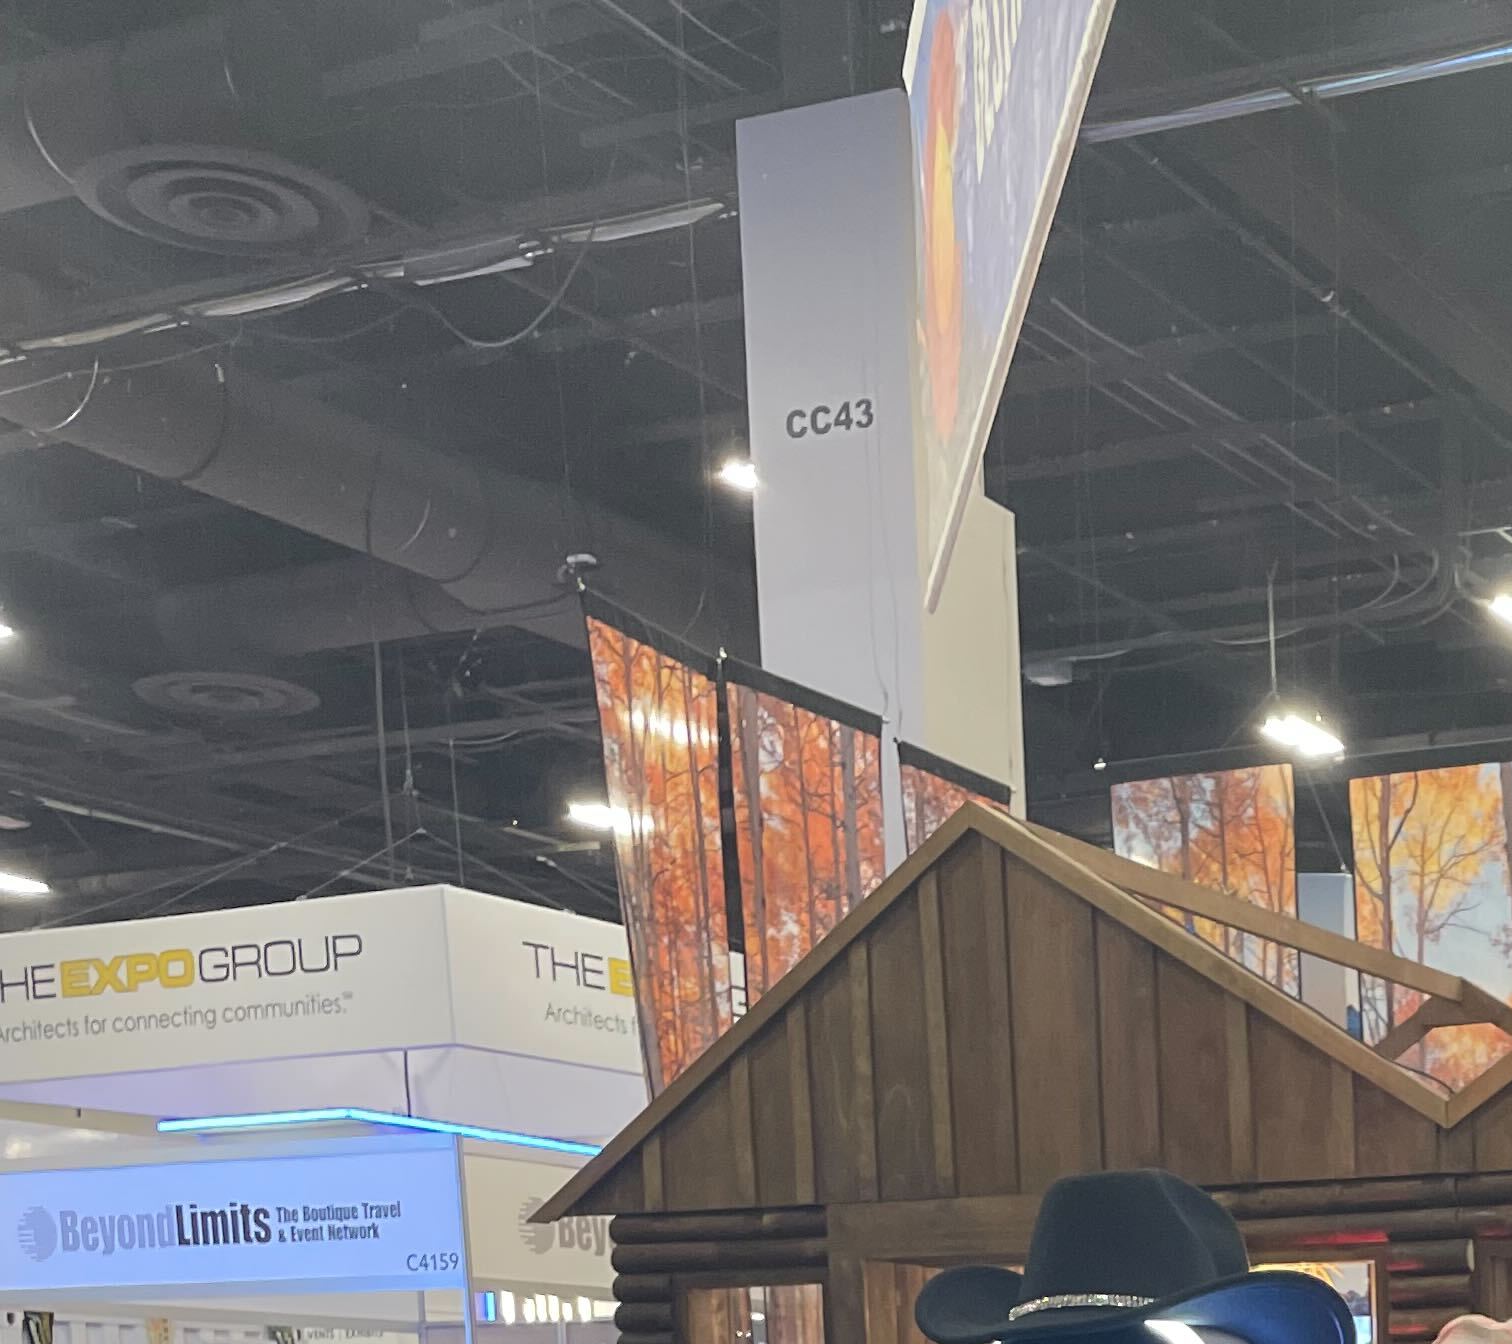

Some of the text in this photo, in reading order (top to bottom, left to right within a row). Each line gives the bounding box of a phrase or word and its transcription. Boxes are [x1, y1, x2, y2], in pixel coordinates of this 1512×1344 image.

[786, 398, 874, 438] CC43
[0, 934, 363, 1001] HE EXPO GROUP
[84, 1015, 107, 1035] for
[112, 1005, 217, 1034] connecting
[545, 1002, 628, 1034] Architects
[276, 1200, 402, 1224] The Boutique Travel
[278, 1222, 380, 1243] & Event Network
[406, 1252, 459, 1271] C4159
